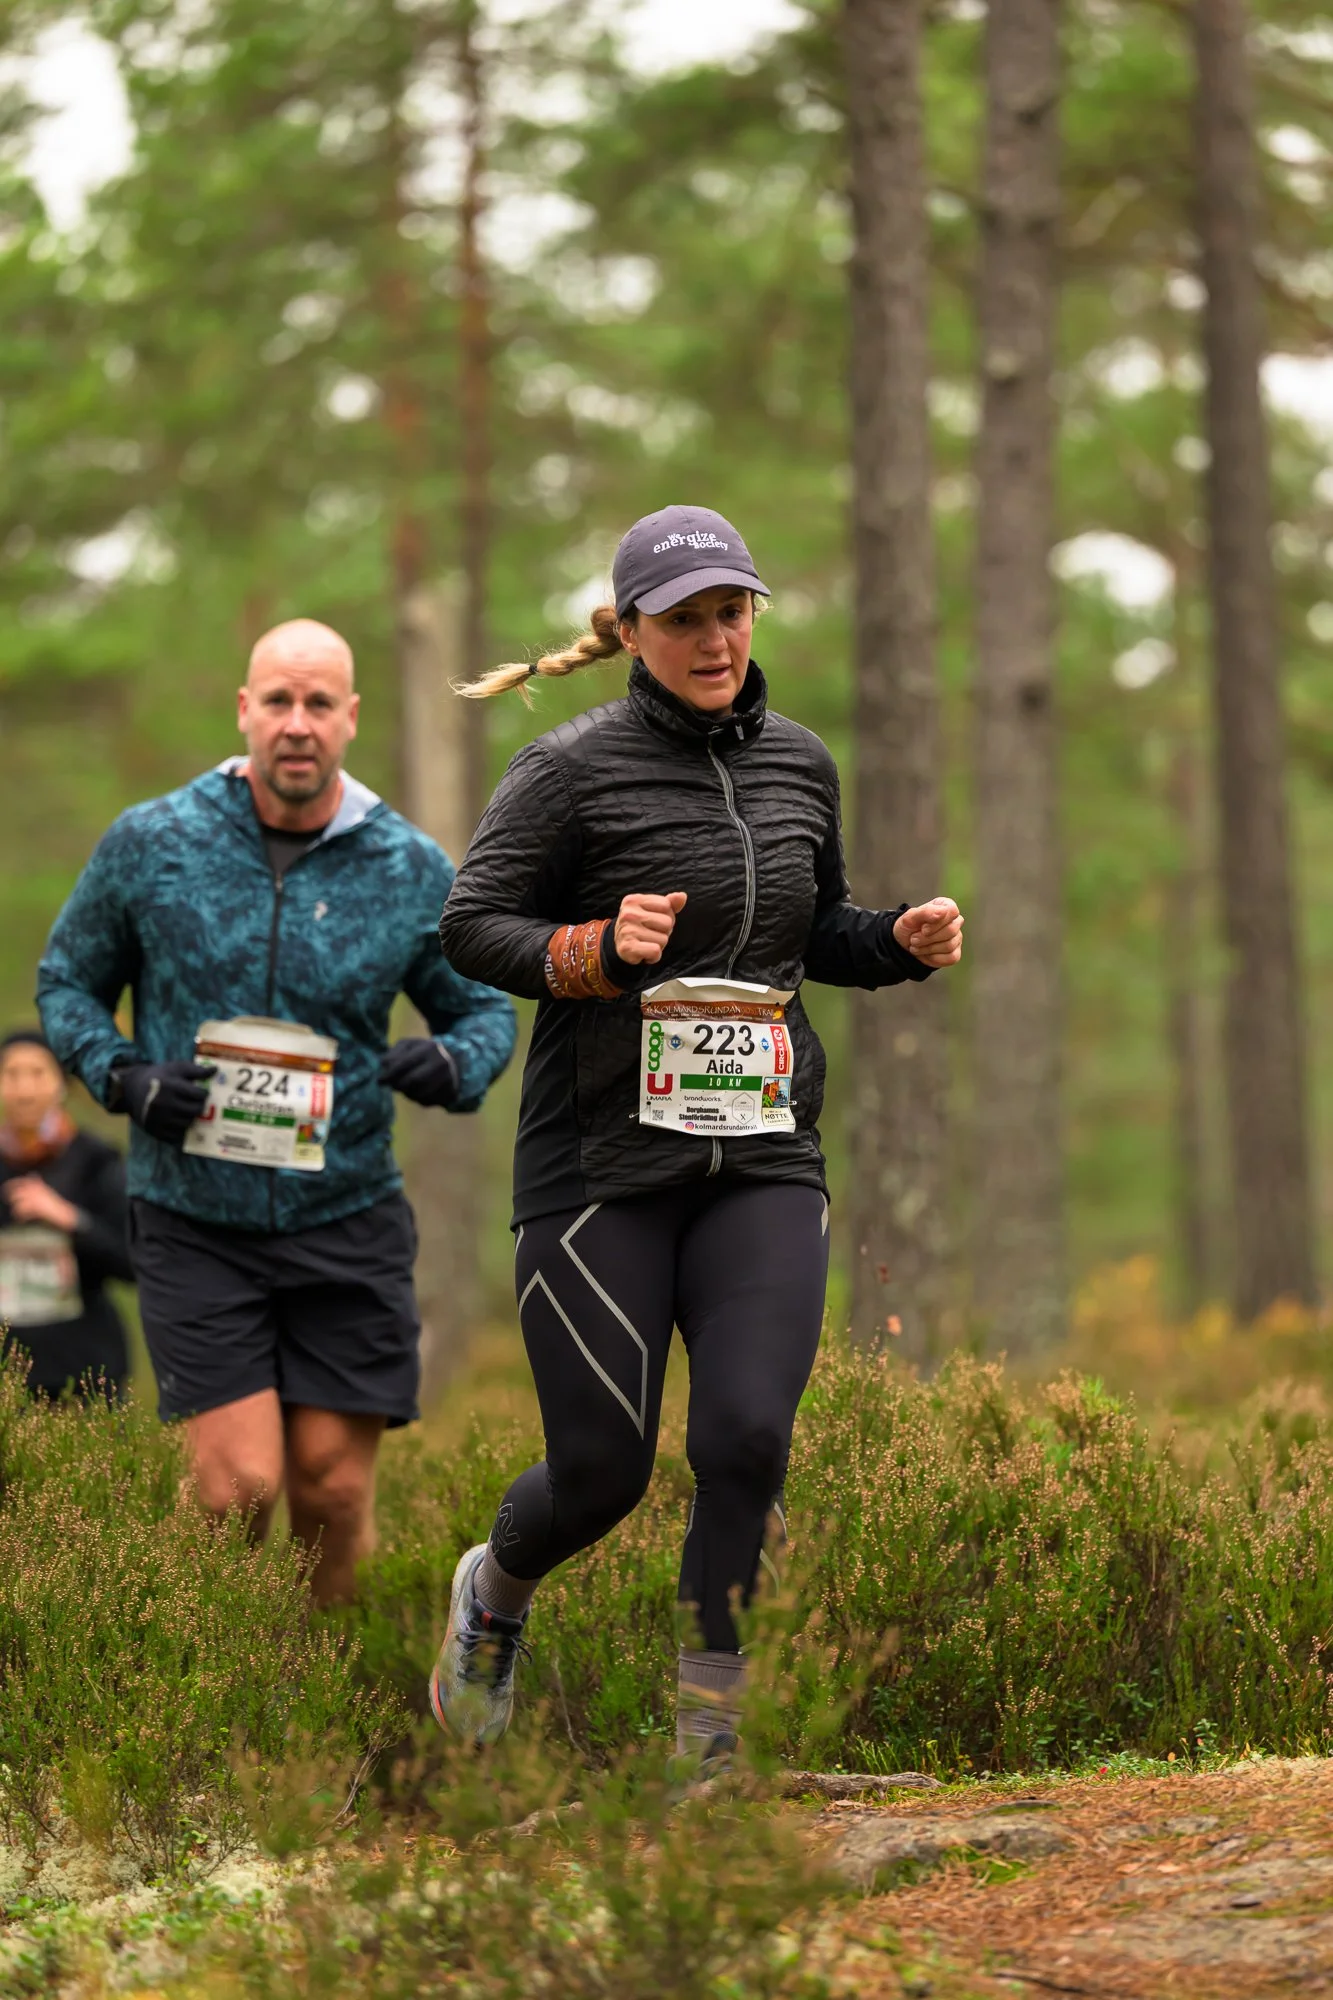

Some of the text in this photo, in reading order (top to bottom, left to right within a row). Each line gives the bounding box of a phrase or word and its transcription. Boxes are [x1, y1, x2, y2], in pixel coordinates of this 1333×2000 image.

[653, 530, 716, 553] energize
[694, 541, 728, 551] society
[648, 1022, 664, 1072] coop
[692, 1024, 755, 1056] 223
[706, 1059, 743, 1074] Aida
[777, 1041, 785, 1071] CIRCLE
[236, 1068, 290, 1098] 224
[709, 1077, 742, 1087] 10 KM
